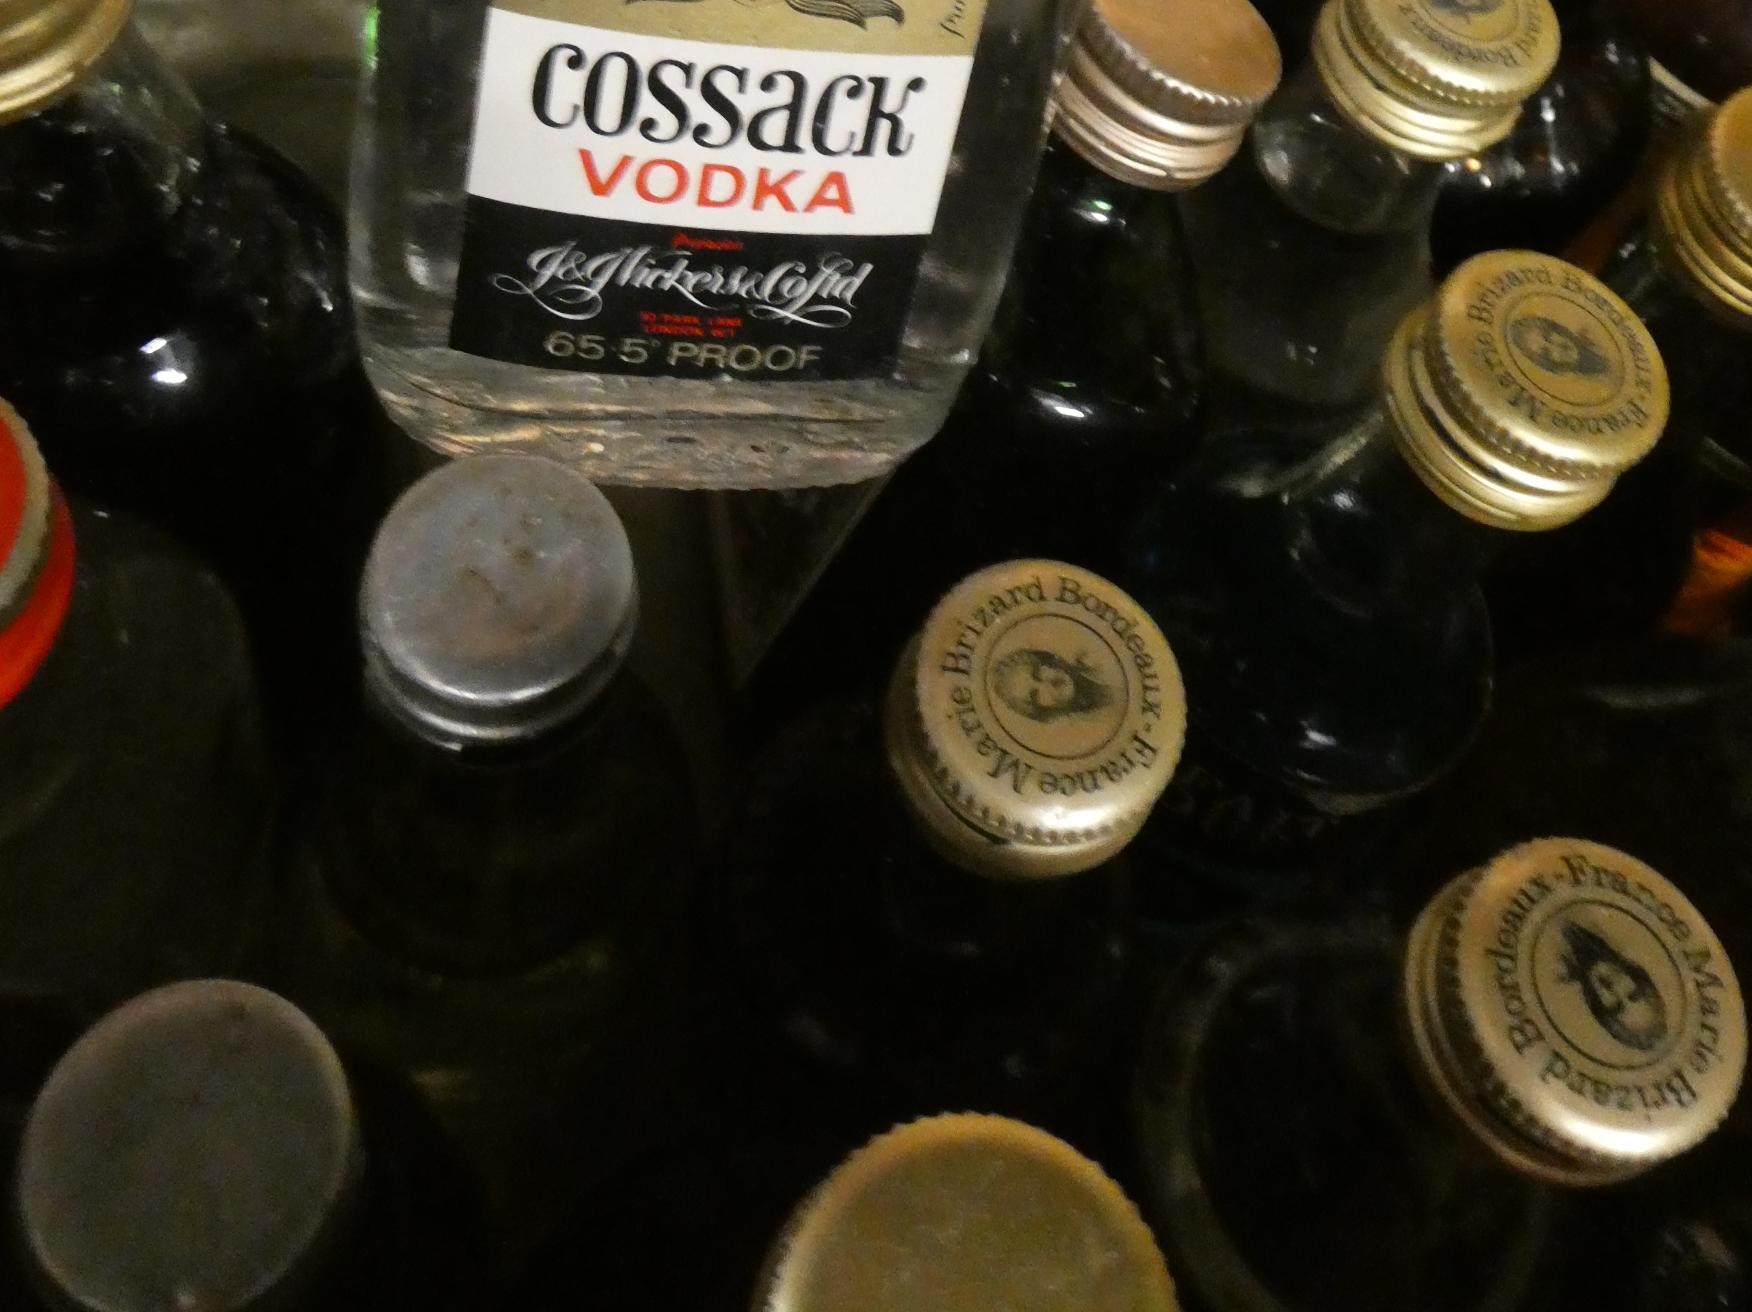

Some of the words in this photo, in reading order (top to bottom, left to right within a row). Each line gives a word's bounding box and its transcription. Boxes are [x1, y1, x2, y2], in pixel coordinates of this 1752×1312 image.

[577, 147, 857, 216] VODKA
[666, 340, 824, 372] PROOF
[1467, 265, 1553, 325] Brizard
[1551, 399, 1649, 436] France
[941, 575, 1048, 678] Brizard
[1055, 575, 1162, 721] Bordeaux
[947, 686, 1037, 796] Marie
[1039, 729, 1158, 797] France
[1560, 853, 1691, 943] France
[1485, 875, 1552, 1057] Bordeaux
[1681, 943, 1725, 1075] Marie
[1540, 1047, 1698, 1112] Brizard
